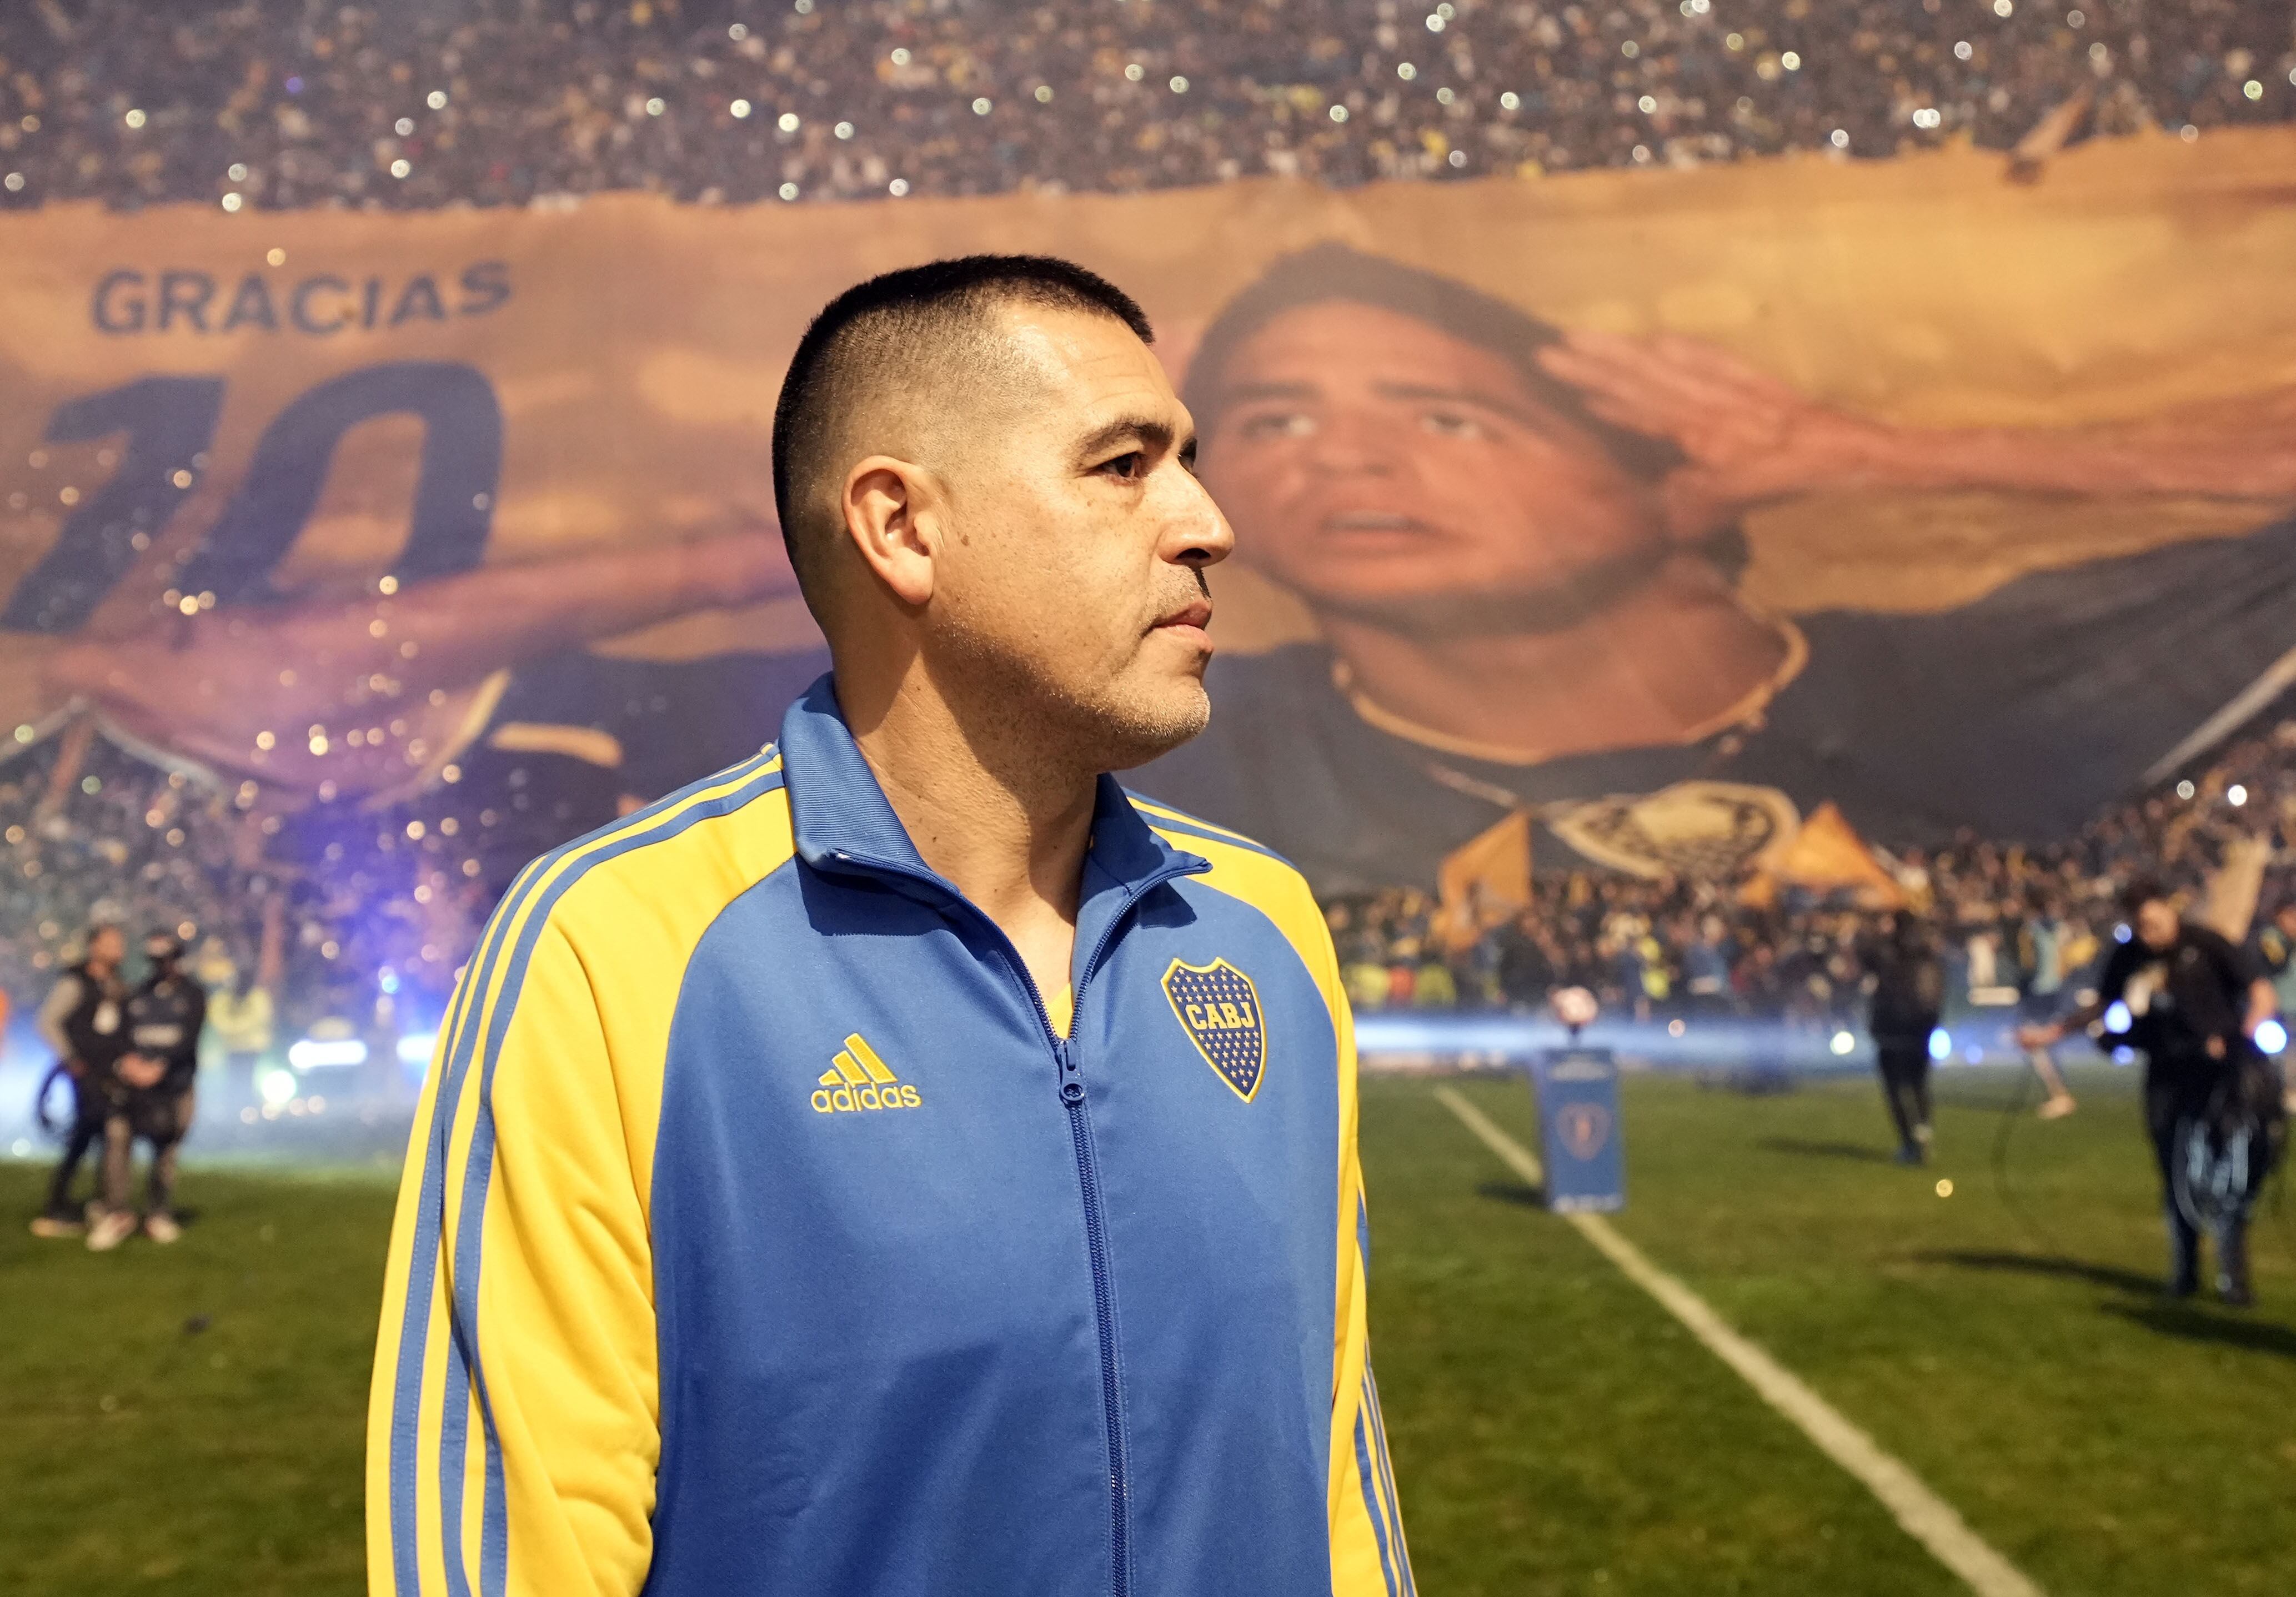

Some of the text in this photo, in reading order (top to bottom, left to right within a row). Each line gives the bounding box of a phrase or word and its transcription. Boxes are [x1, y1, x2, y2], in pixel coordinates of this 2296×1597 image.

[91, 260, 513, 334] GRACIAS
[0, 360, 506, 635] 10
[1185, 1001, 1256, 1030] CABJ
[811, 1082, 922, 1113] adidas
